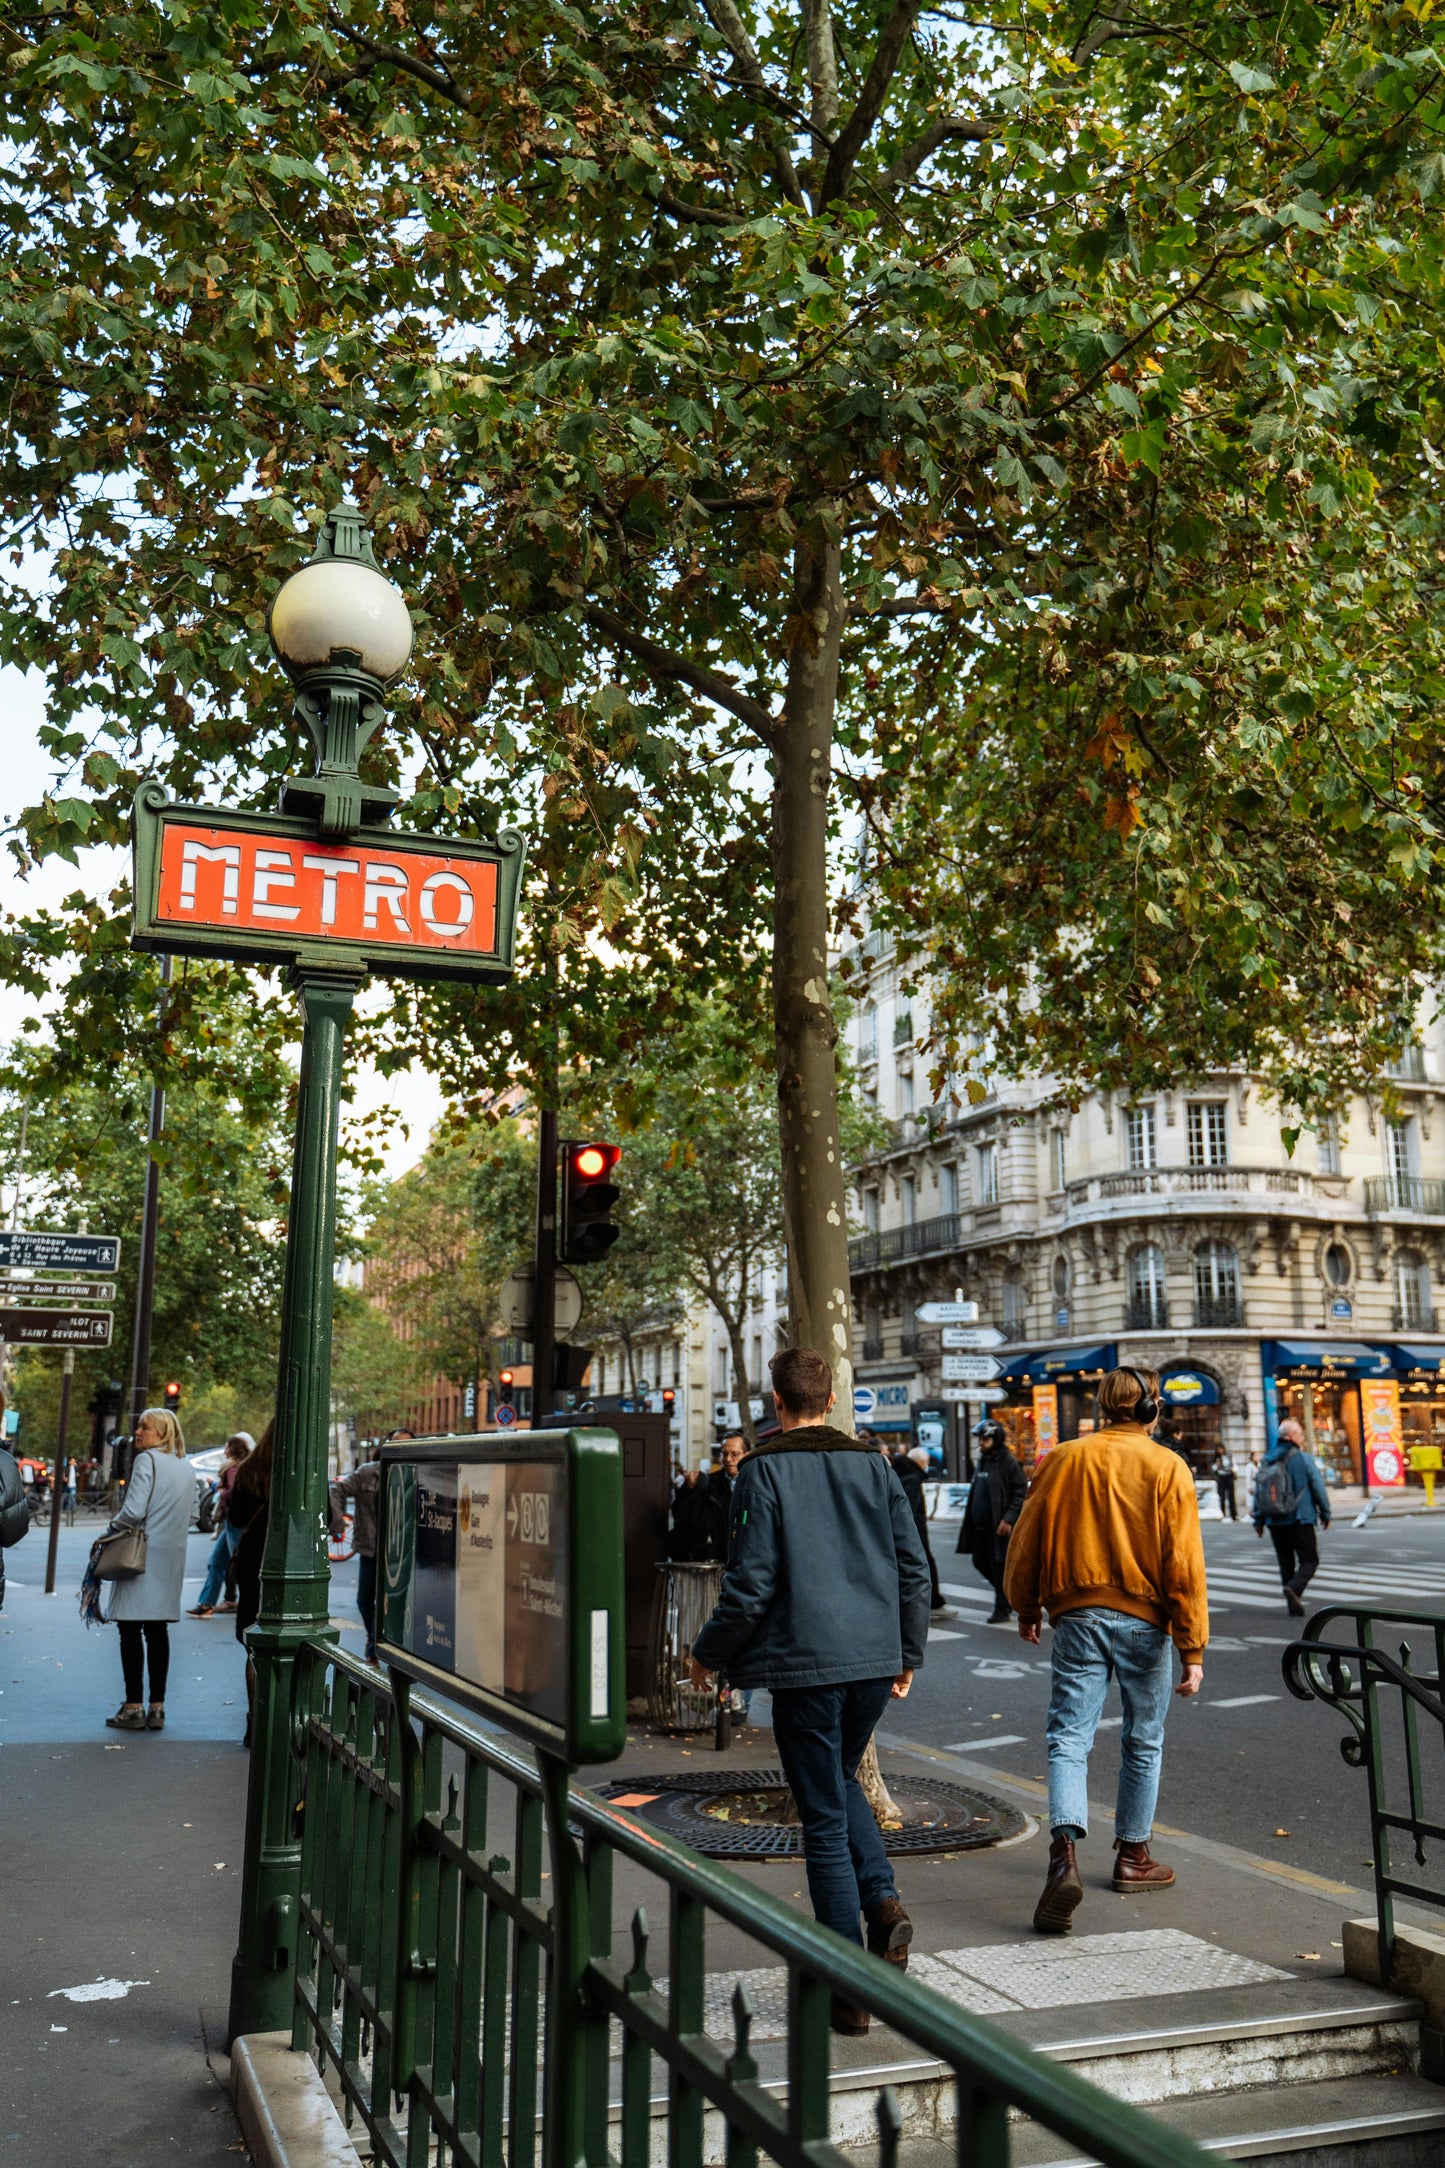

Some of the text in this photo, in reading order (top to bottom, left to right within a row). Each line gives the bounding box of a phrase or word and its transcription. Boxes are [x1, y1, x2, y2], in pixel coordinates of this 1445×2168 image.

[179, 839, 475, 938] METRO
[11, 1235, 66, 1246] Bibliothèque
[34, 1285, 54, 1293] Saint
[57, 1286, 90, 1295] SEVERIN
[21, 1328, 90, 1339] SAINT SEVERIN
[877, 1386, 909, 1406] MICRO
[428, 1511, 453, 1534] St-Jacques
